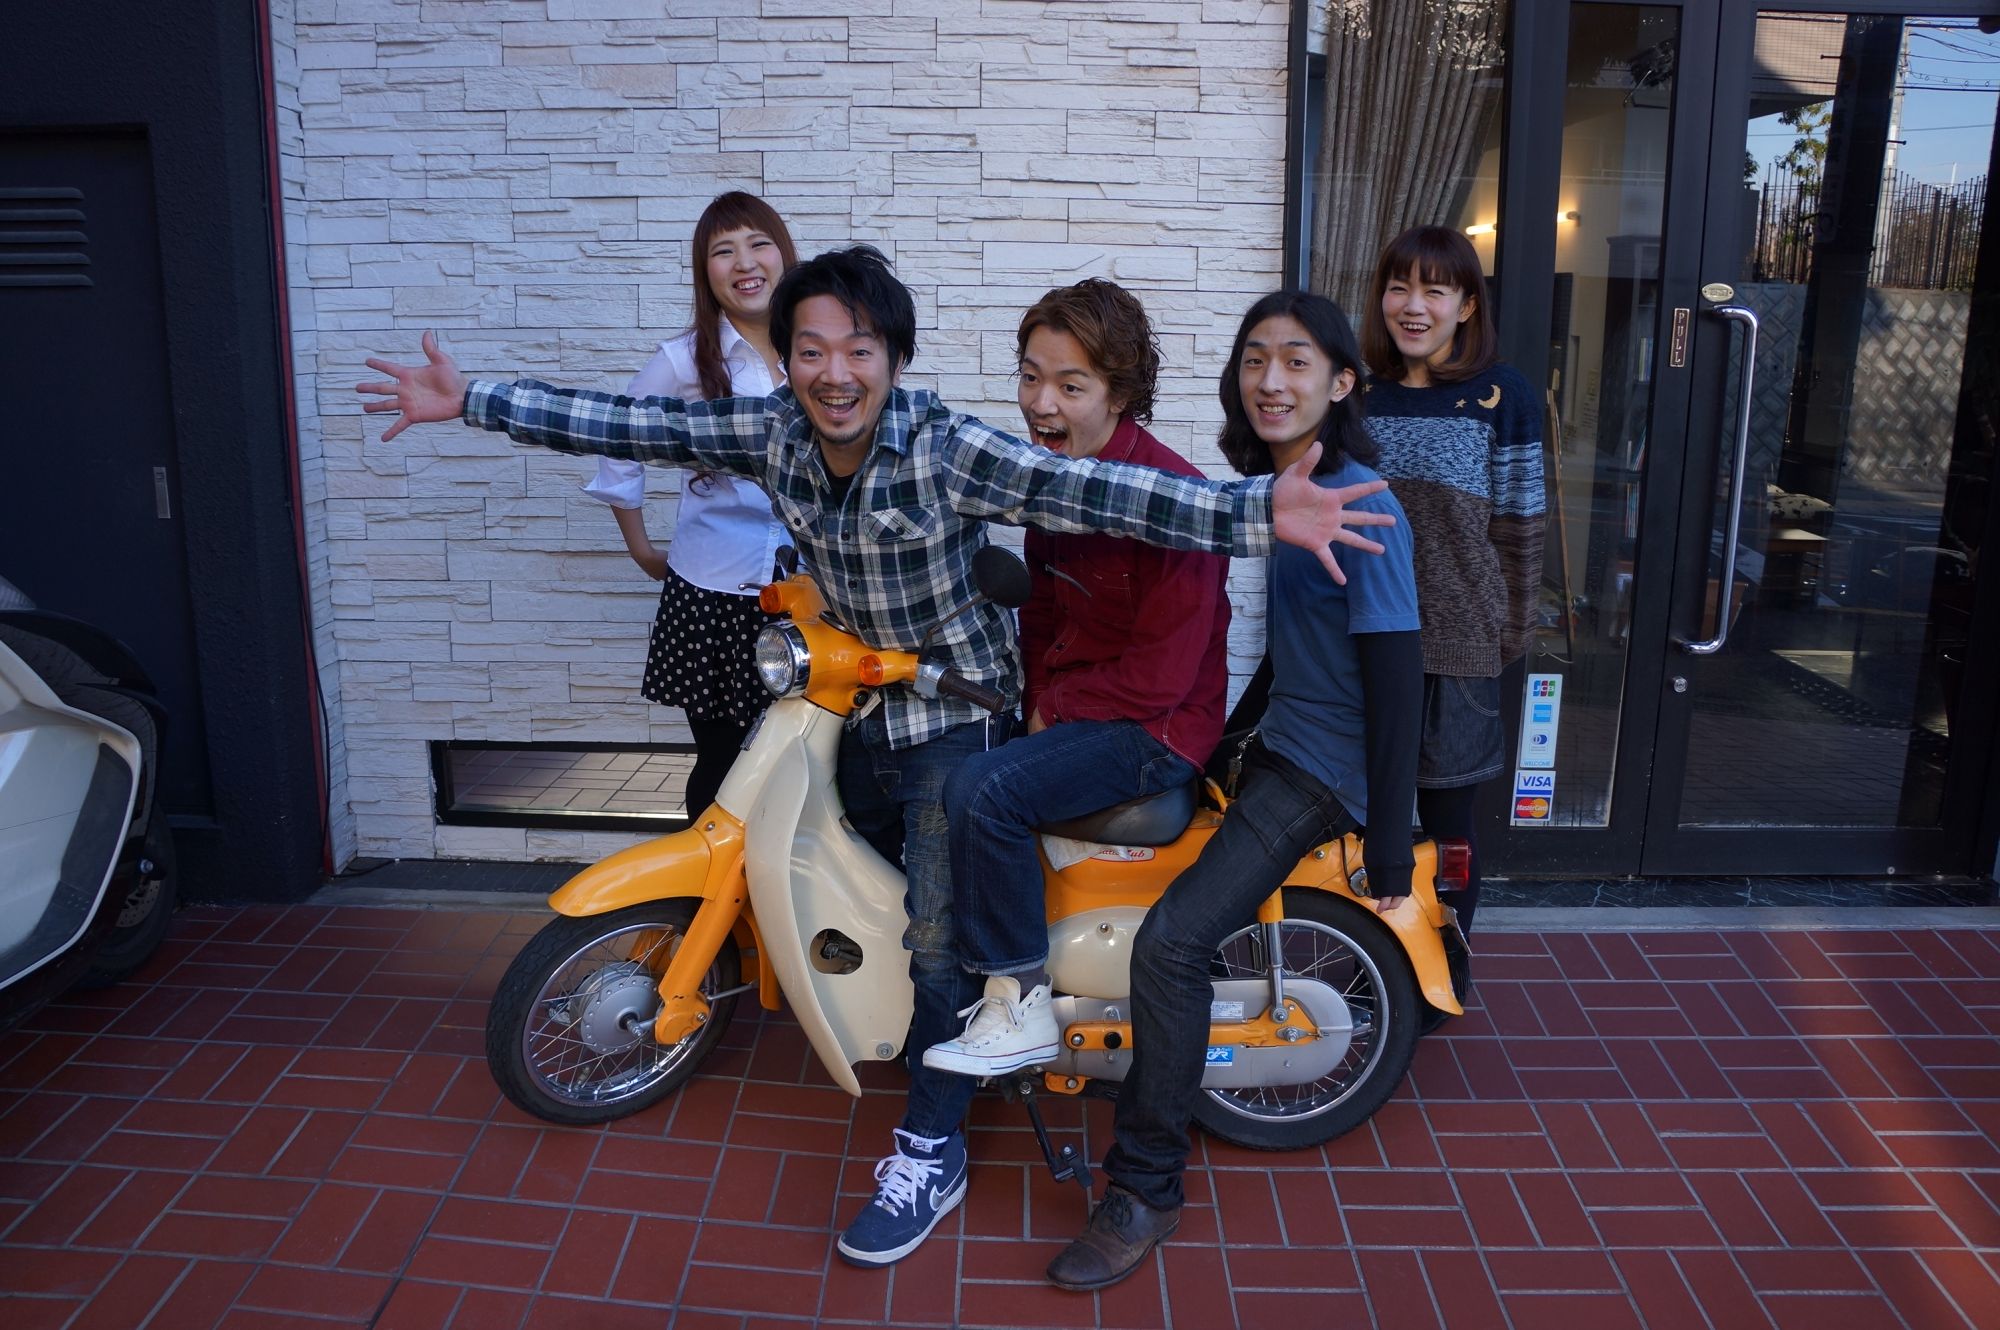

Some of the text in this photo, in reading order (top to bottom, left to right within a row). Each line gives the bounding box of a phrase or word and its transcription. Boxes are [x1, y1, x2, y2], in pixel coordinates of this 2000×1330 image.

[1675, 312, 1685, 363] PULL
[1533, 680, 1556, 697] JCB
[1522, 776, 1552, 787] VISA
